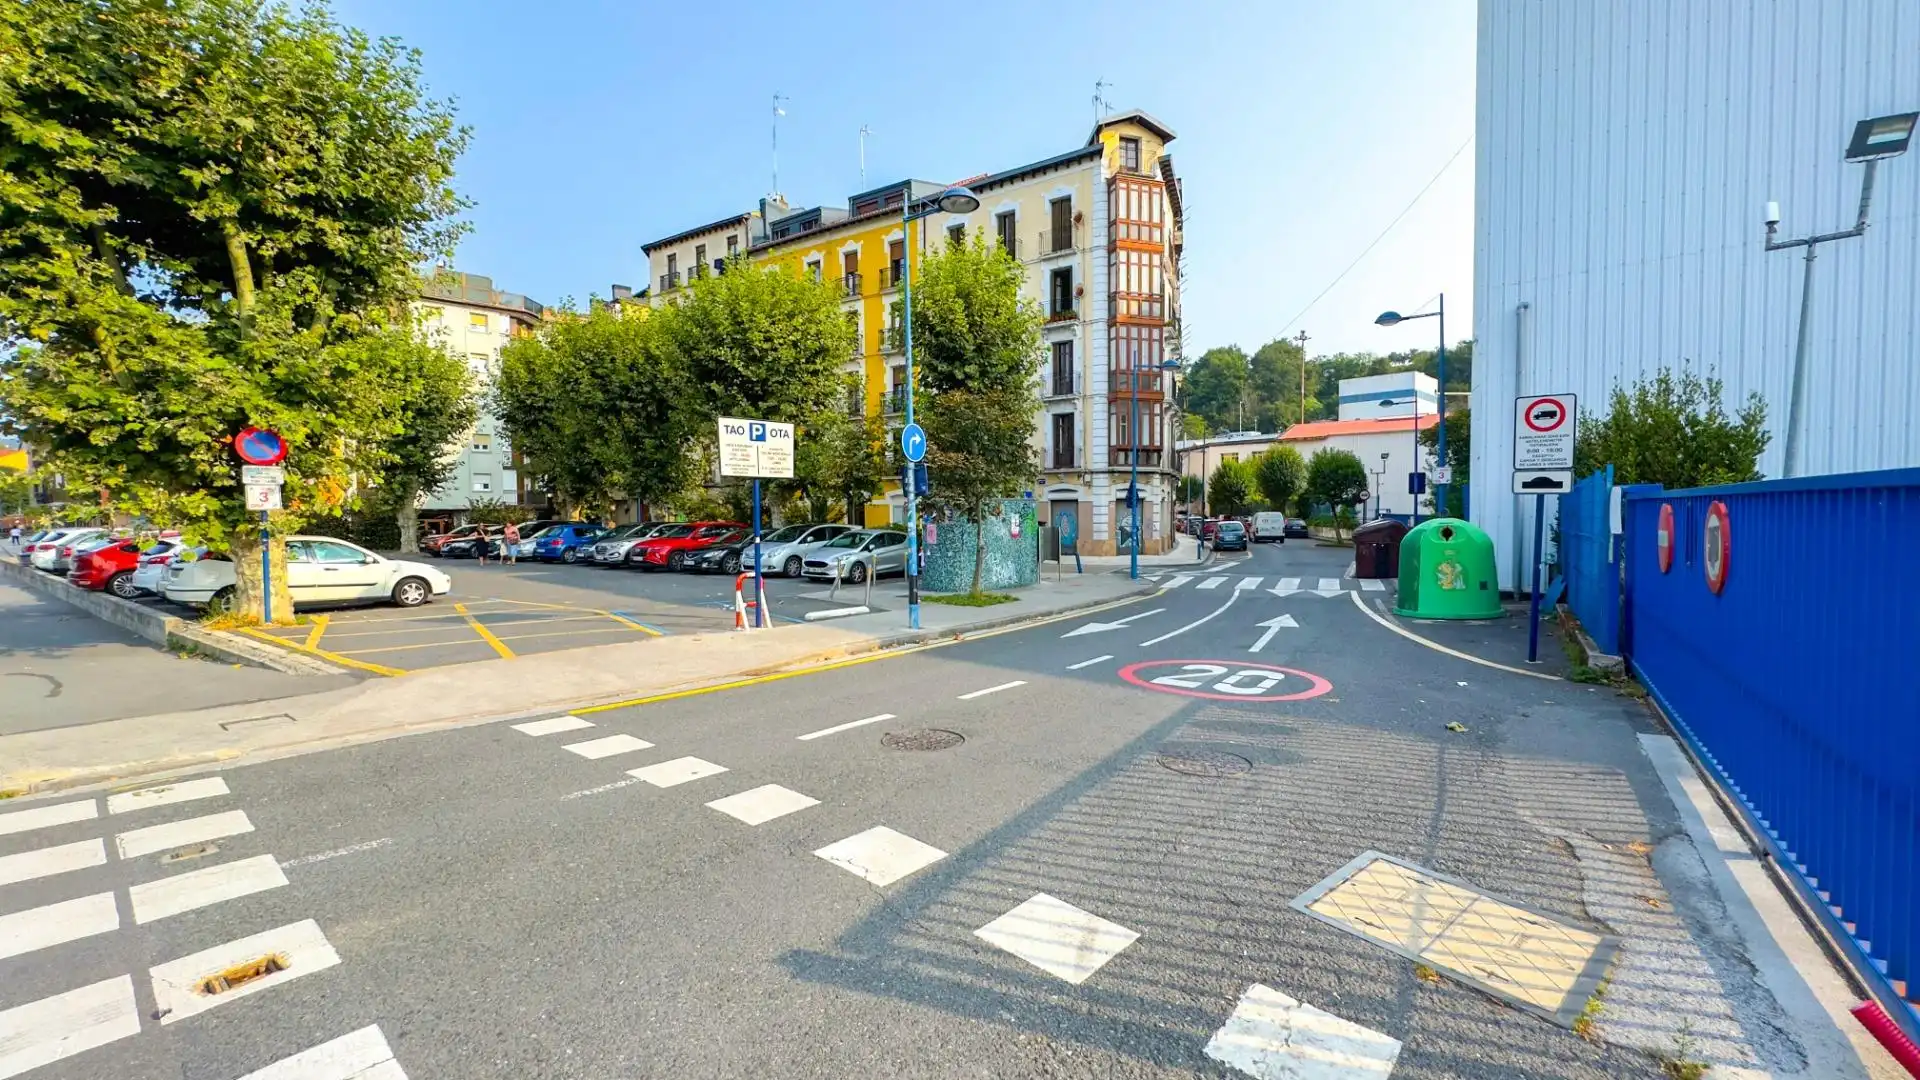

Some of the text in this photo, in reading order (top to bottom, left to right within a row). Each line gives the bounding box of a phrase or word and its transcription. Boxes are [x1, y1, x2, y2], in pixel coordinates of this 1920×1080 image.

[724, 424, 790, 440] TAO P OTA
[1439, 471, 1445, 479] 3
[259, 492, 269, 503] 3
[1151, 664, 1285, 695] 20
